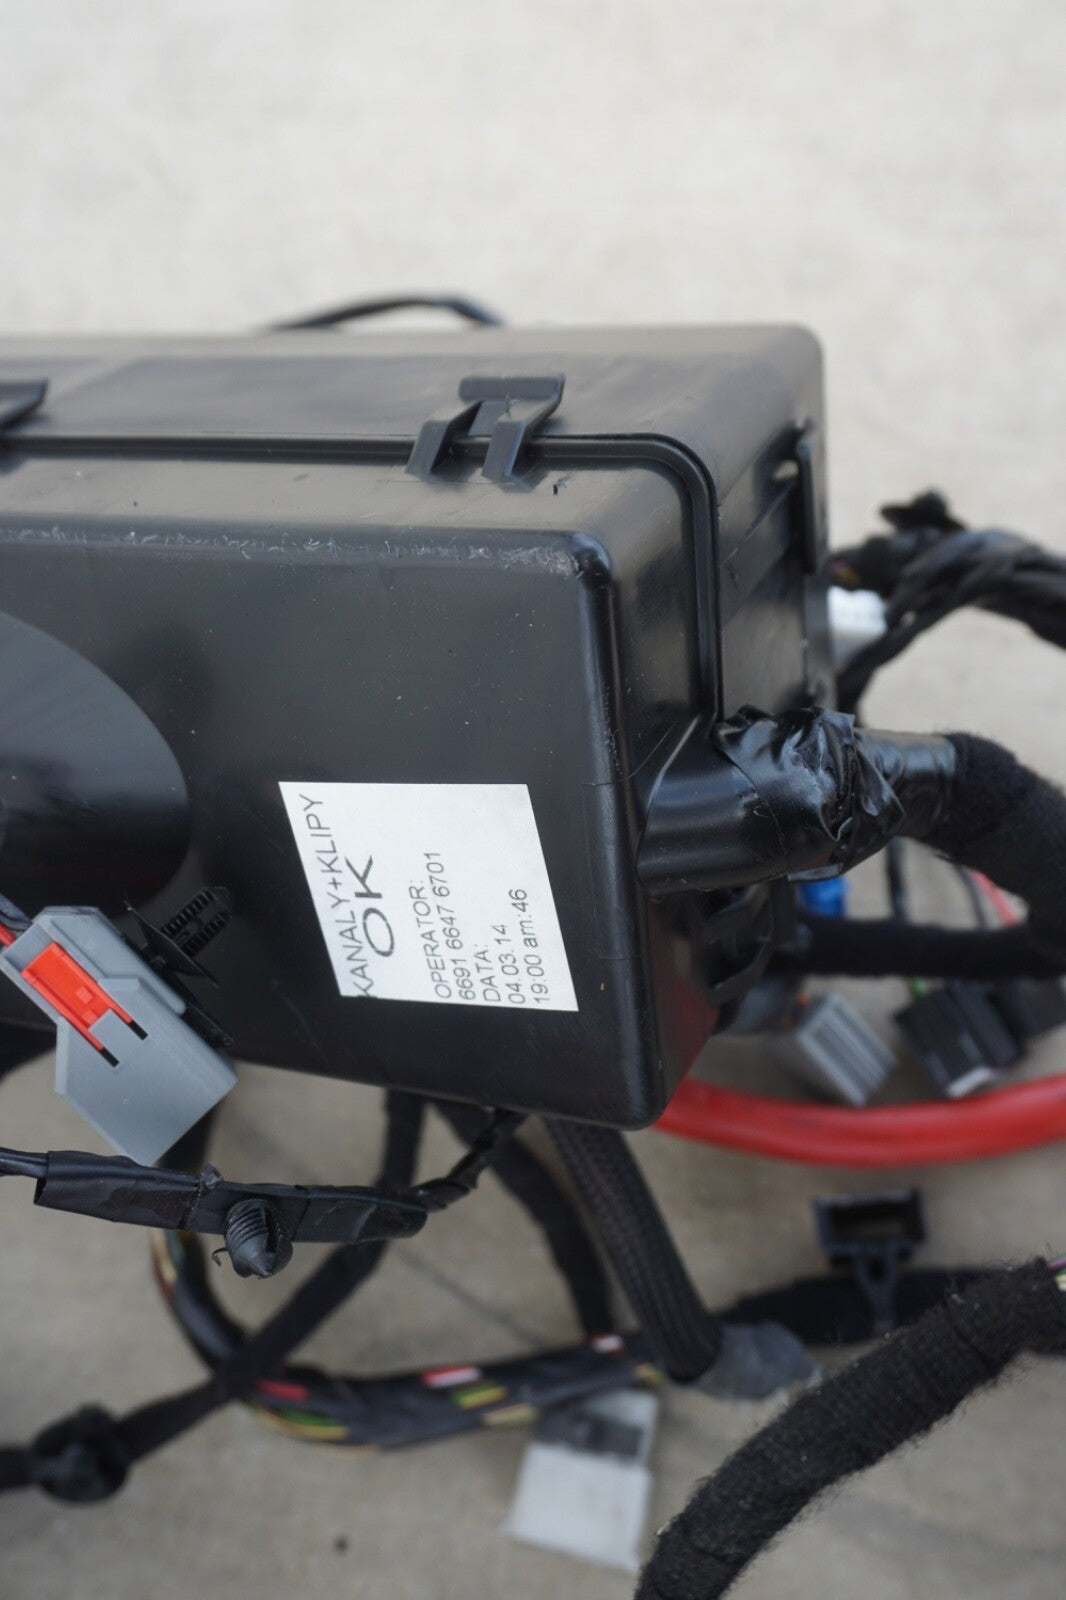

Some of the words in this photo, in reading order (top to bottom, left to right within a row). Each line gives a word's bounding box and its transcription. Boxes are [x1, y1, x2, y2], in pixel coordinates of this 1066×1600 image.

[299, 793, 374, 998] KANALY+KLIPY
[424, 852, 450, 897] 6701
[345, 855, 395, 957] OK
[437, 905, 464, 951] 6647
[409, 880, 451, 999] OPERATOR:
[492, 924, 525, 1005] 04.03.14
[452, 957, 476, 1000] 6691
[474, 944, 500, 1002] DATA:
[526, 954, 549, 1003] 19:00
